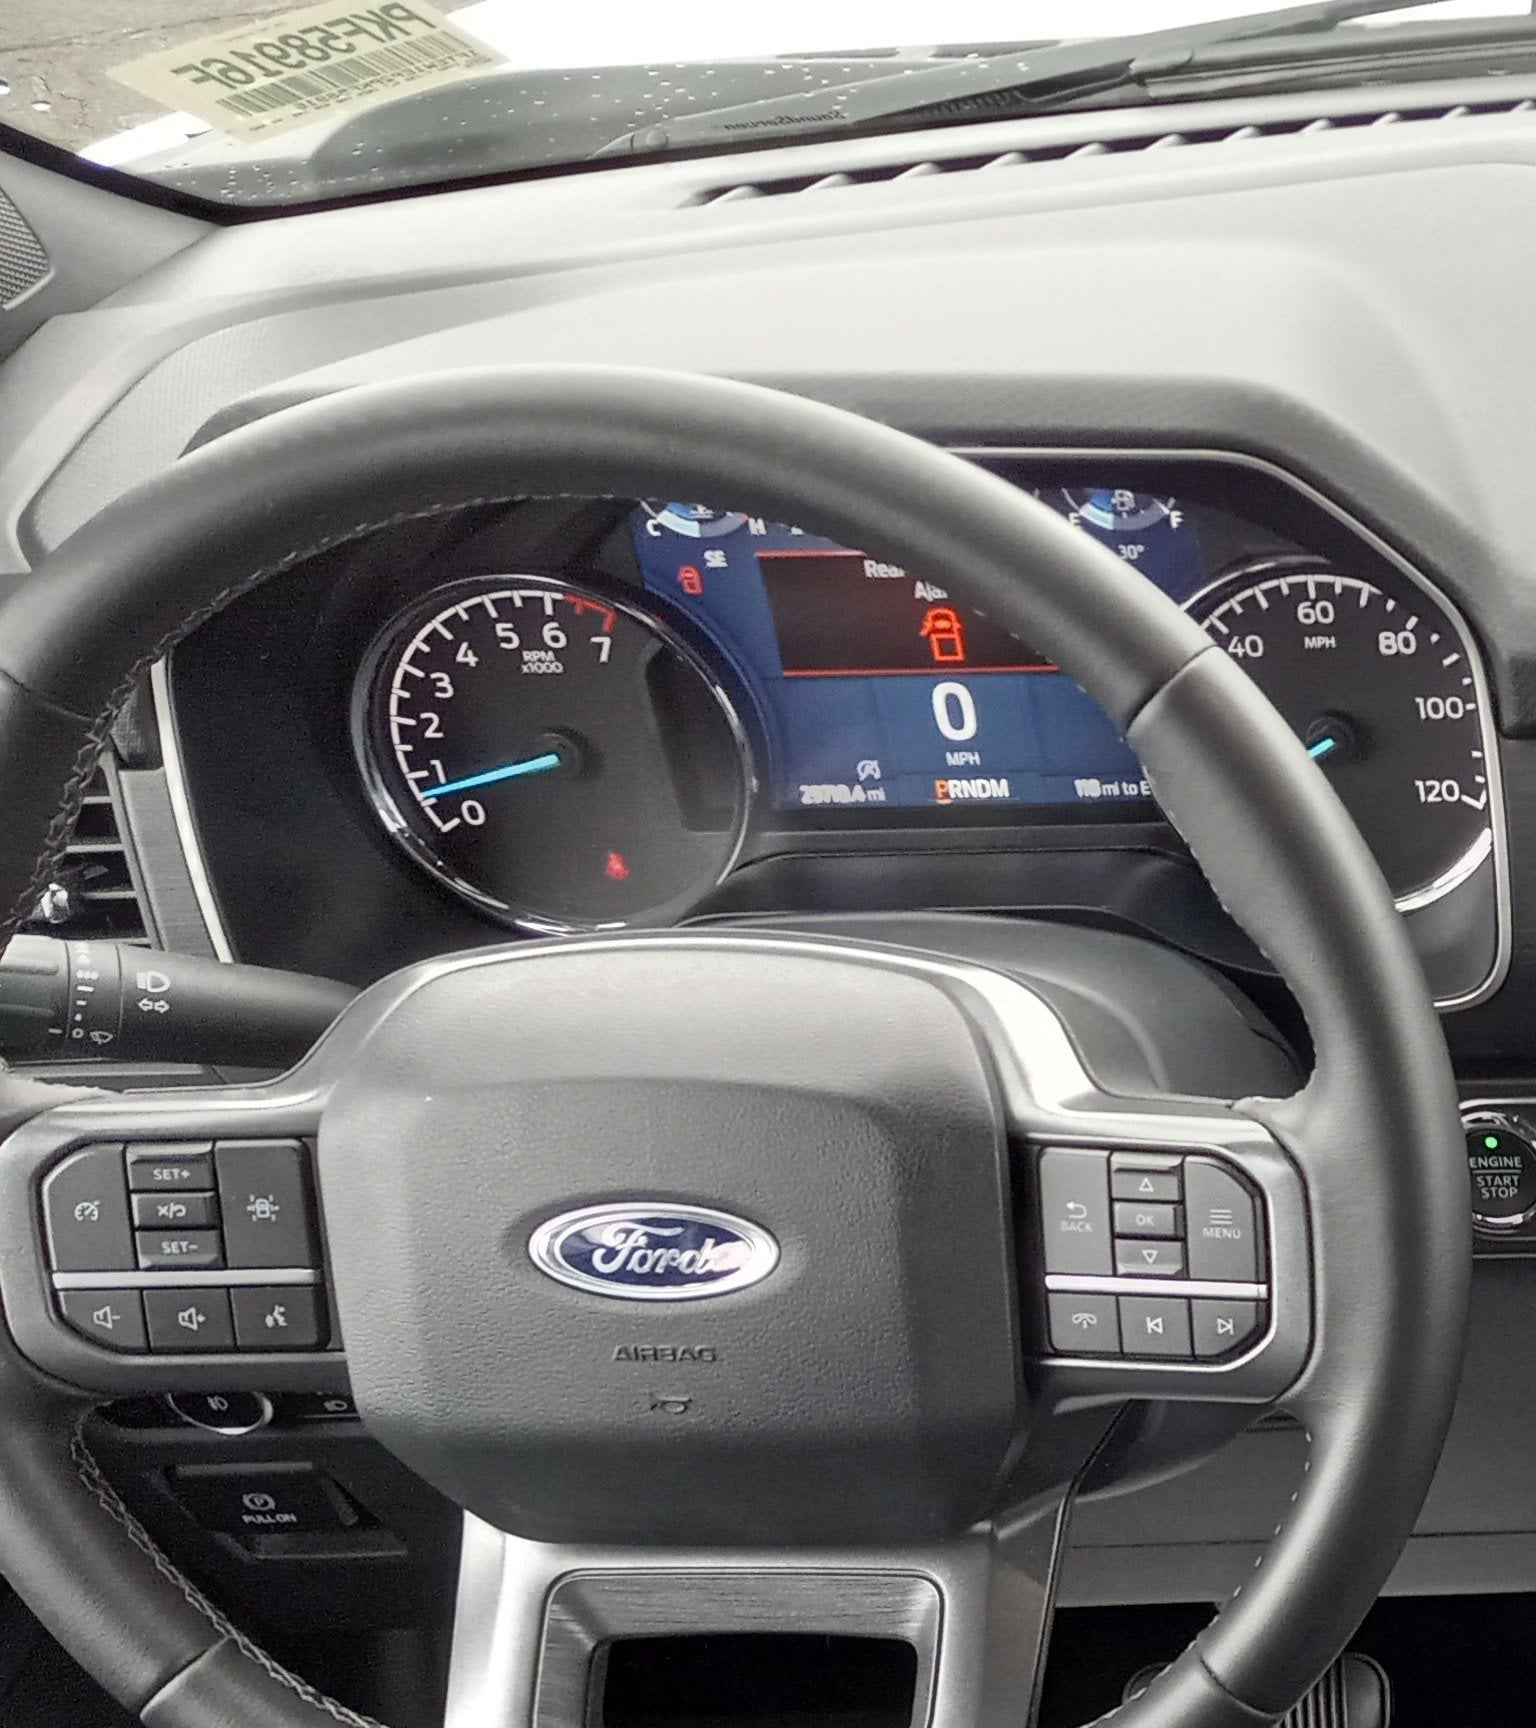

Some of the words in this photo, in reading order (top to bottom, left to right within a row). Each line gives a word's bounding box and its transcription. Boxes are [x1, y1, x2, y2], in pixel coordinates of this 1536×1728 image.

[1297, 602, 1334, 625] 60
[496, 623, 519, 650] 5
[543, 621, 567, 648] 6
[1304, 635, 1336, 650] MPH
[1378, 631, 1416, 656] 80
[455, 642, 478, 667] 4
[522, 650, 556, 662] RPM
[590, 636, 613, 663] 7
[1228, 635, 1264, 658] 40
[431, 673, 454, 699] 3
[931, 681, 977, 742] 0
[1415, 696, 1464, 720] 100
[420, 713, 443, 738] 2
[946, 752, 980, 766] MPH
[430, 760, 446, 783] 1
[1415, 780, 1460, 803] 120
[461, 801, 486, 825] 0
[1469, 1155, 1523, 1169] ENGINE
[1475, 1174, 1520, 1187] START
[1481, 1186, 1518, 1200] STOP
[1060, 1219, 1093, 1233] BACK
[1136, 1214, 1155, 1227] OK
[1203, 1226, 1243, 1240] MENU
[610, 1344, 718, 1364] AIRBAG
